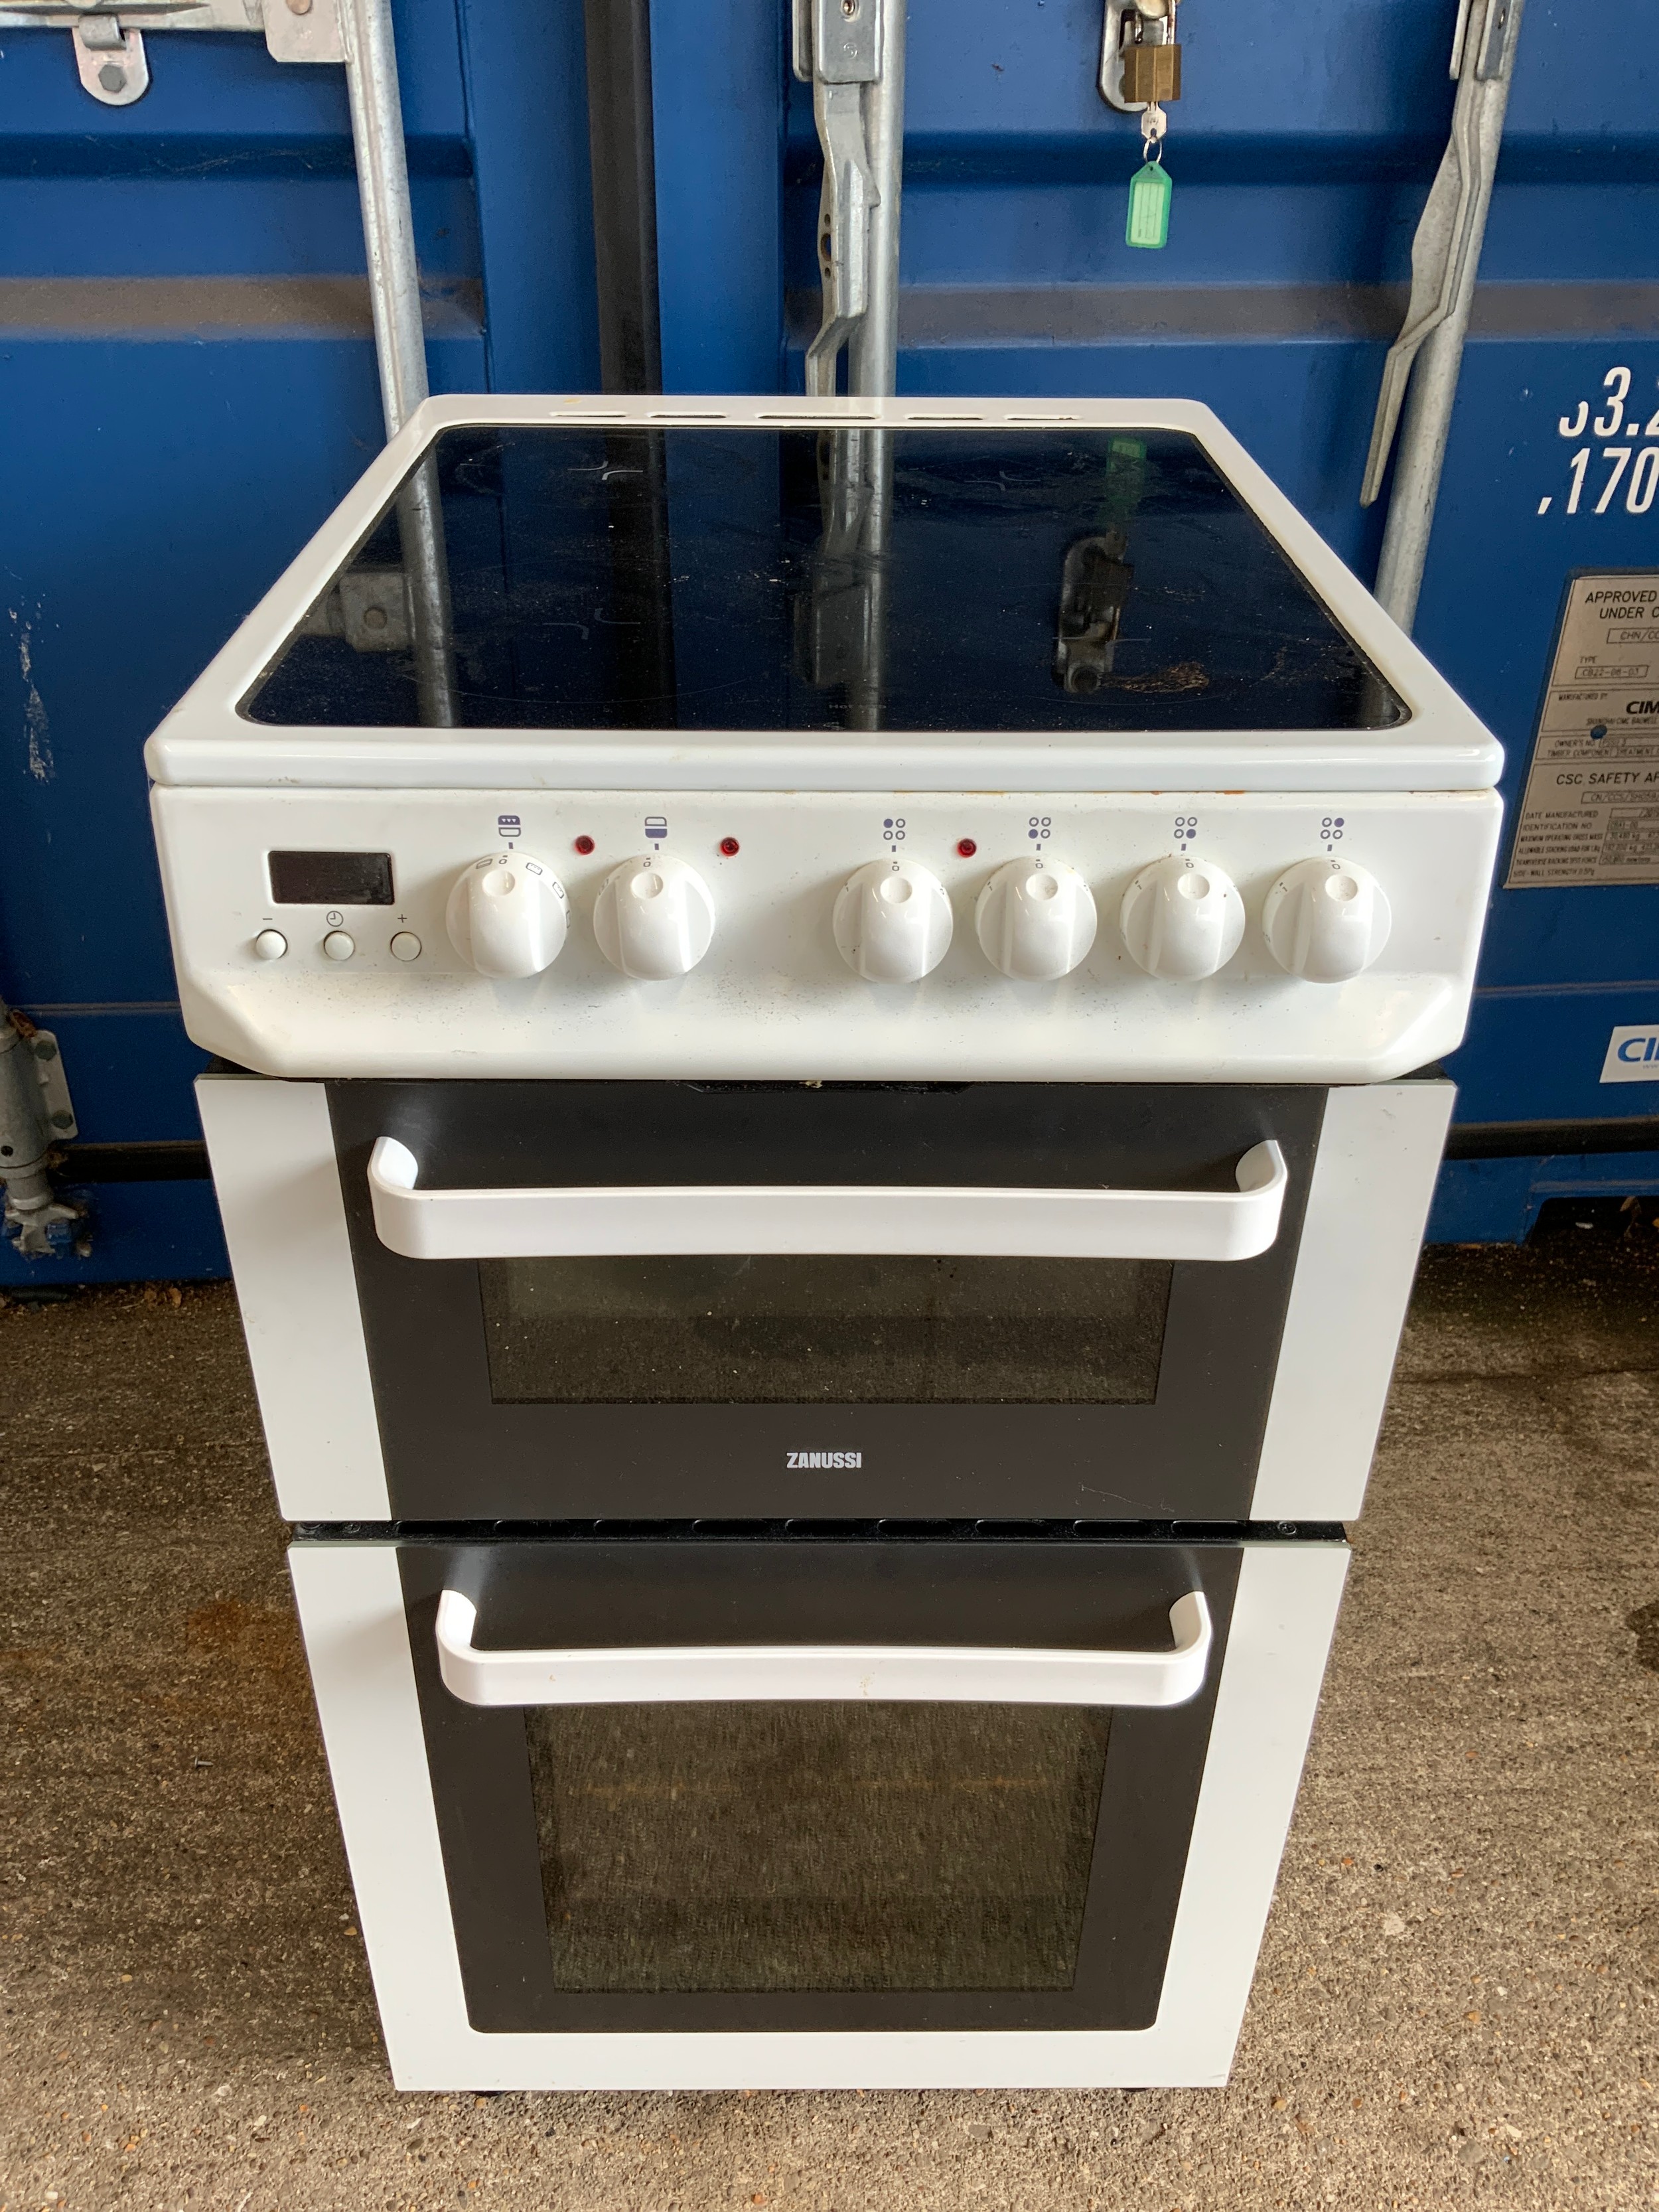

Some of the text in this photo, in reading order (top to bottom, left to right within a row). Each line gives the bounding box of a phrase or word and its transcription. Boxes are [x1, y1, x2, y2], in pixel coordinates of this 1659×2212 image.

[1585, 590, 1658, 603] APPROVED
[1599, 607, 1644, 619] UNDER
[1620, 630, 1659, 641] CHN/CC
[1626, 700, 1659, 714] CIM
[1556, 774, 1583, 785] CSC
[1589, 772, 1640, 784] SAFETY
[1617, 1037, 1659, 1062] CI
[786, 1451, 862, 1469] ZANUSSI
